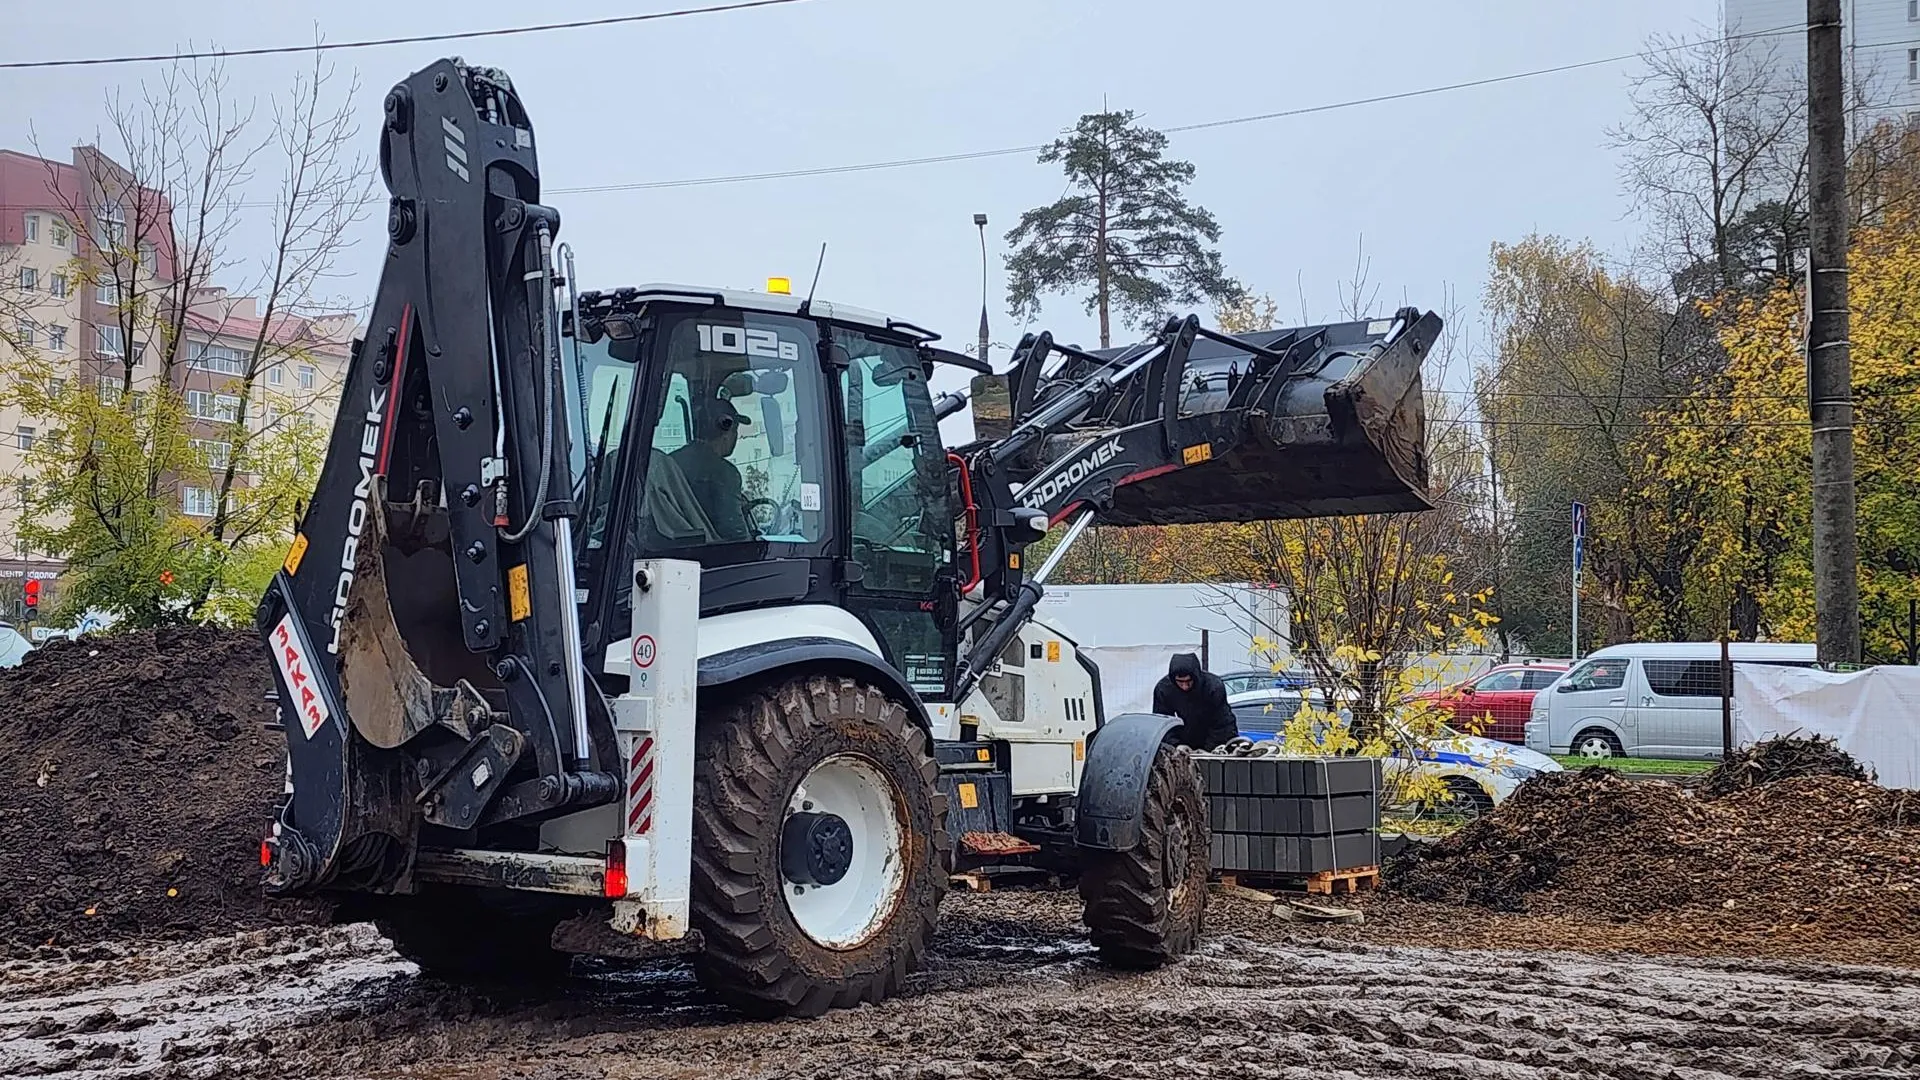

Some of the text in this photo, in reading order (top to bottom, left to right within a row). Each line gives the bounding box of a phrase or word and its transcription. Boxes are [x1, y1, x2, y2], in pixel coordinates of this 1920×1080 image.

[697, 325, 799, 361] 102B
[637, 644, 652, 659] 40
[276, 624, 321, 730] ЗАКАЗ
